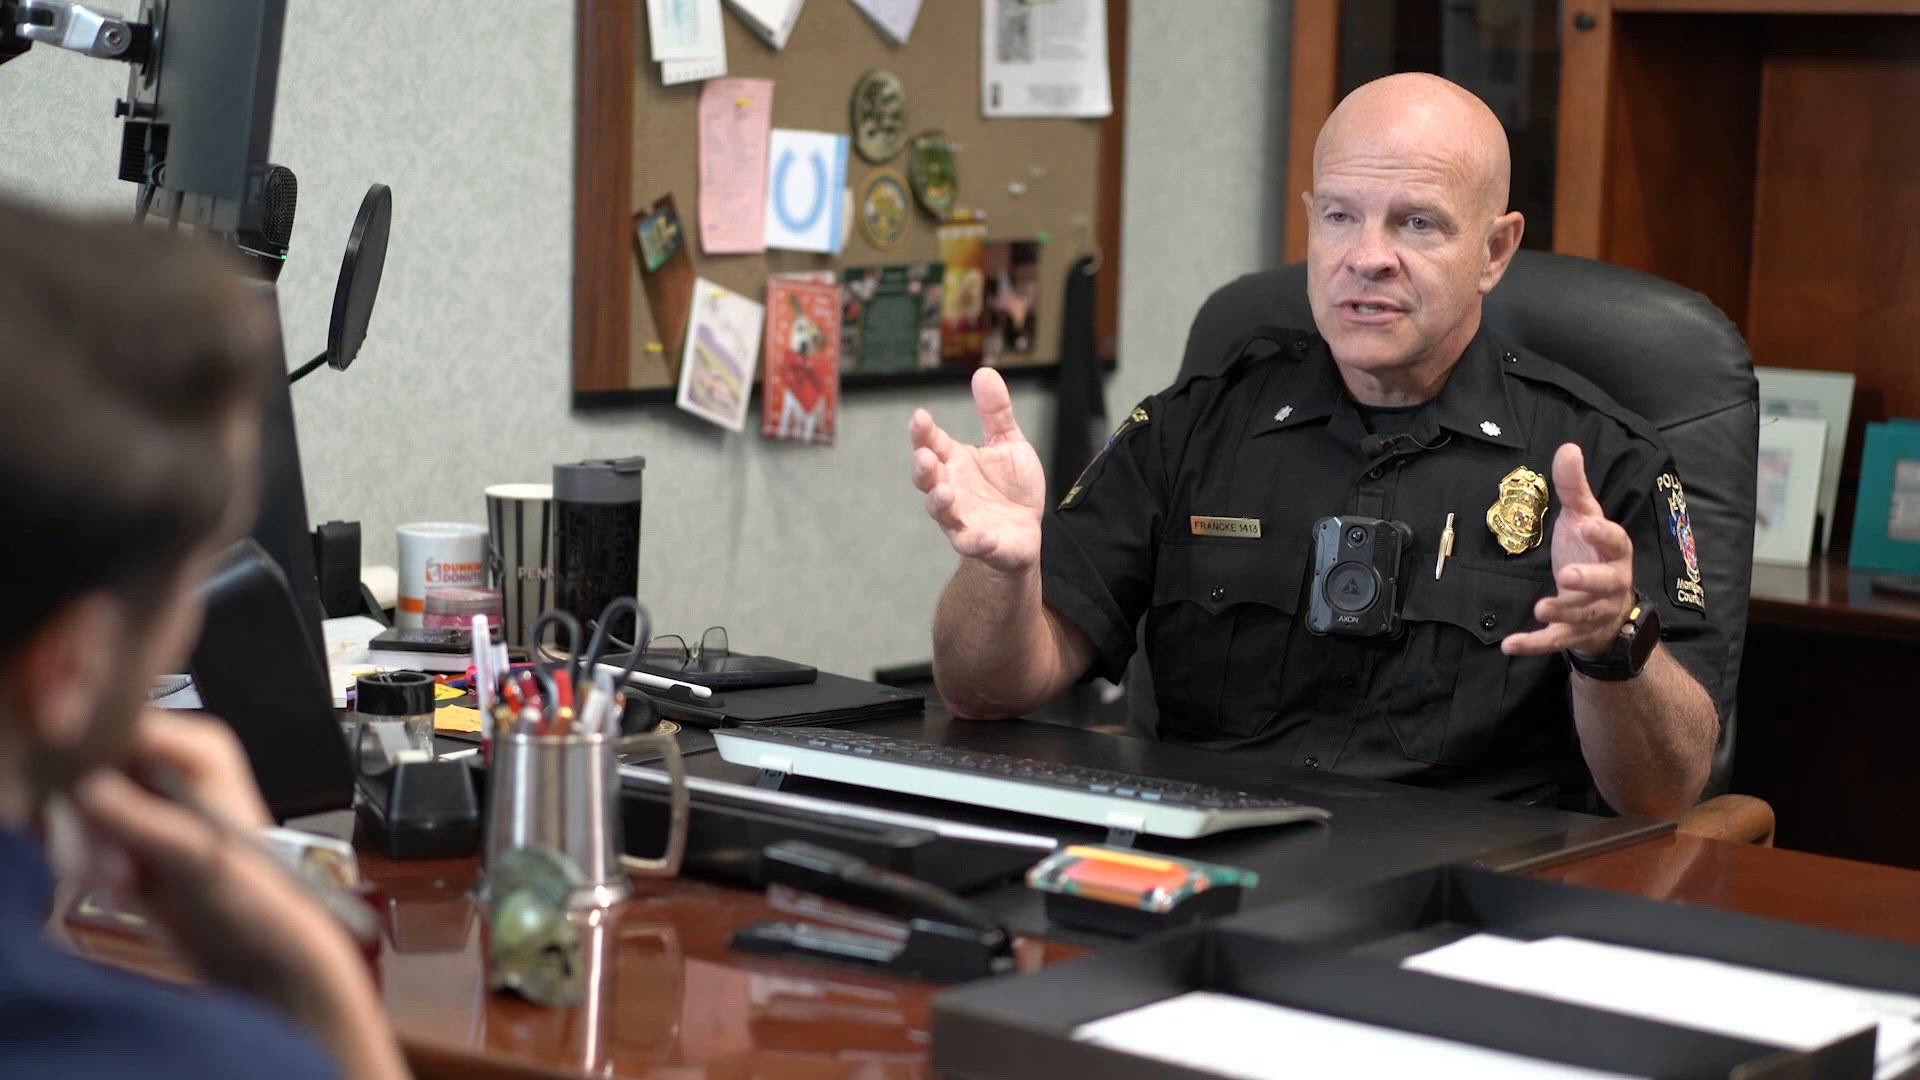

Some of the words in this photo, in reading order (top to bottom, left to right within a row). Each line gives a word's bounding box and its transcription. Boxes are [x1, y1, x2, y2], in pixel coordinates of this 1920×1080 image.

[1194, 520, 1237, 532] FRANCKE
[1239, 523, 1258, 534] 1413
[1338, 615, 1359, 624] AXON
